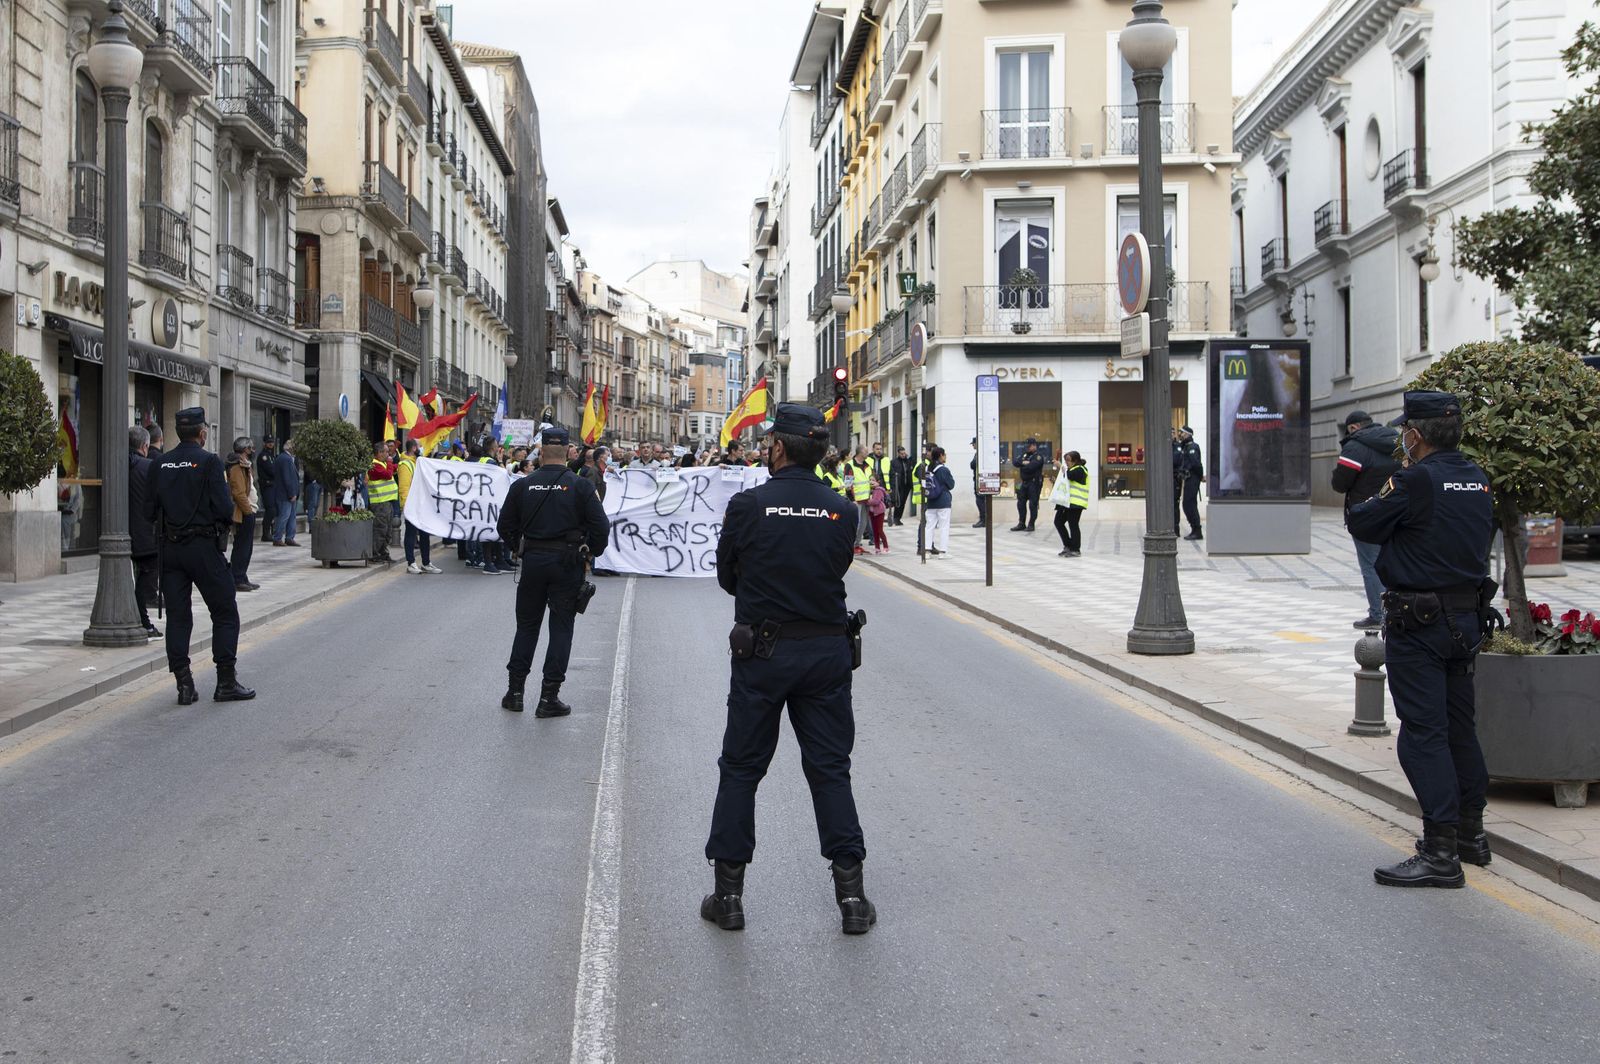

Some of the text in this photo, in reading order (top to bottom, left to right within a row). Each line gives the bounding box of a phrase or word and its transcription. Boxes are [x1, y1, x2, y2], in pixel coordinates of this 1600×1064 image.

[161, 461, 192, 469] POLICIA
[435, 469, 495, 497] POR
[1443, 482, 1484, 492] POLICIA
[616, 469, 715, 517] POR
[765, 507, 830, 519] POLICIA
